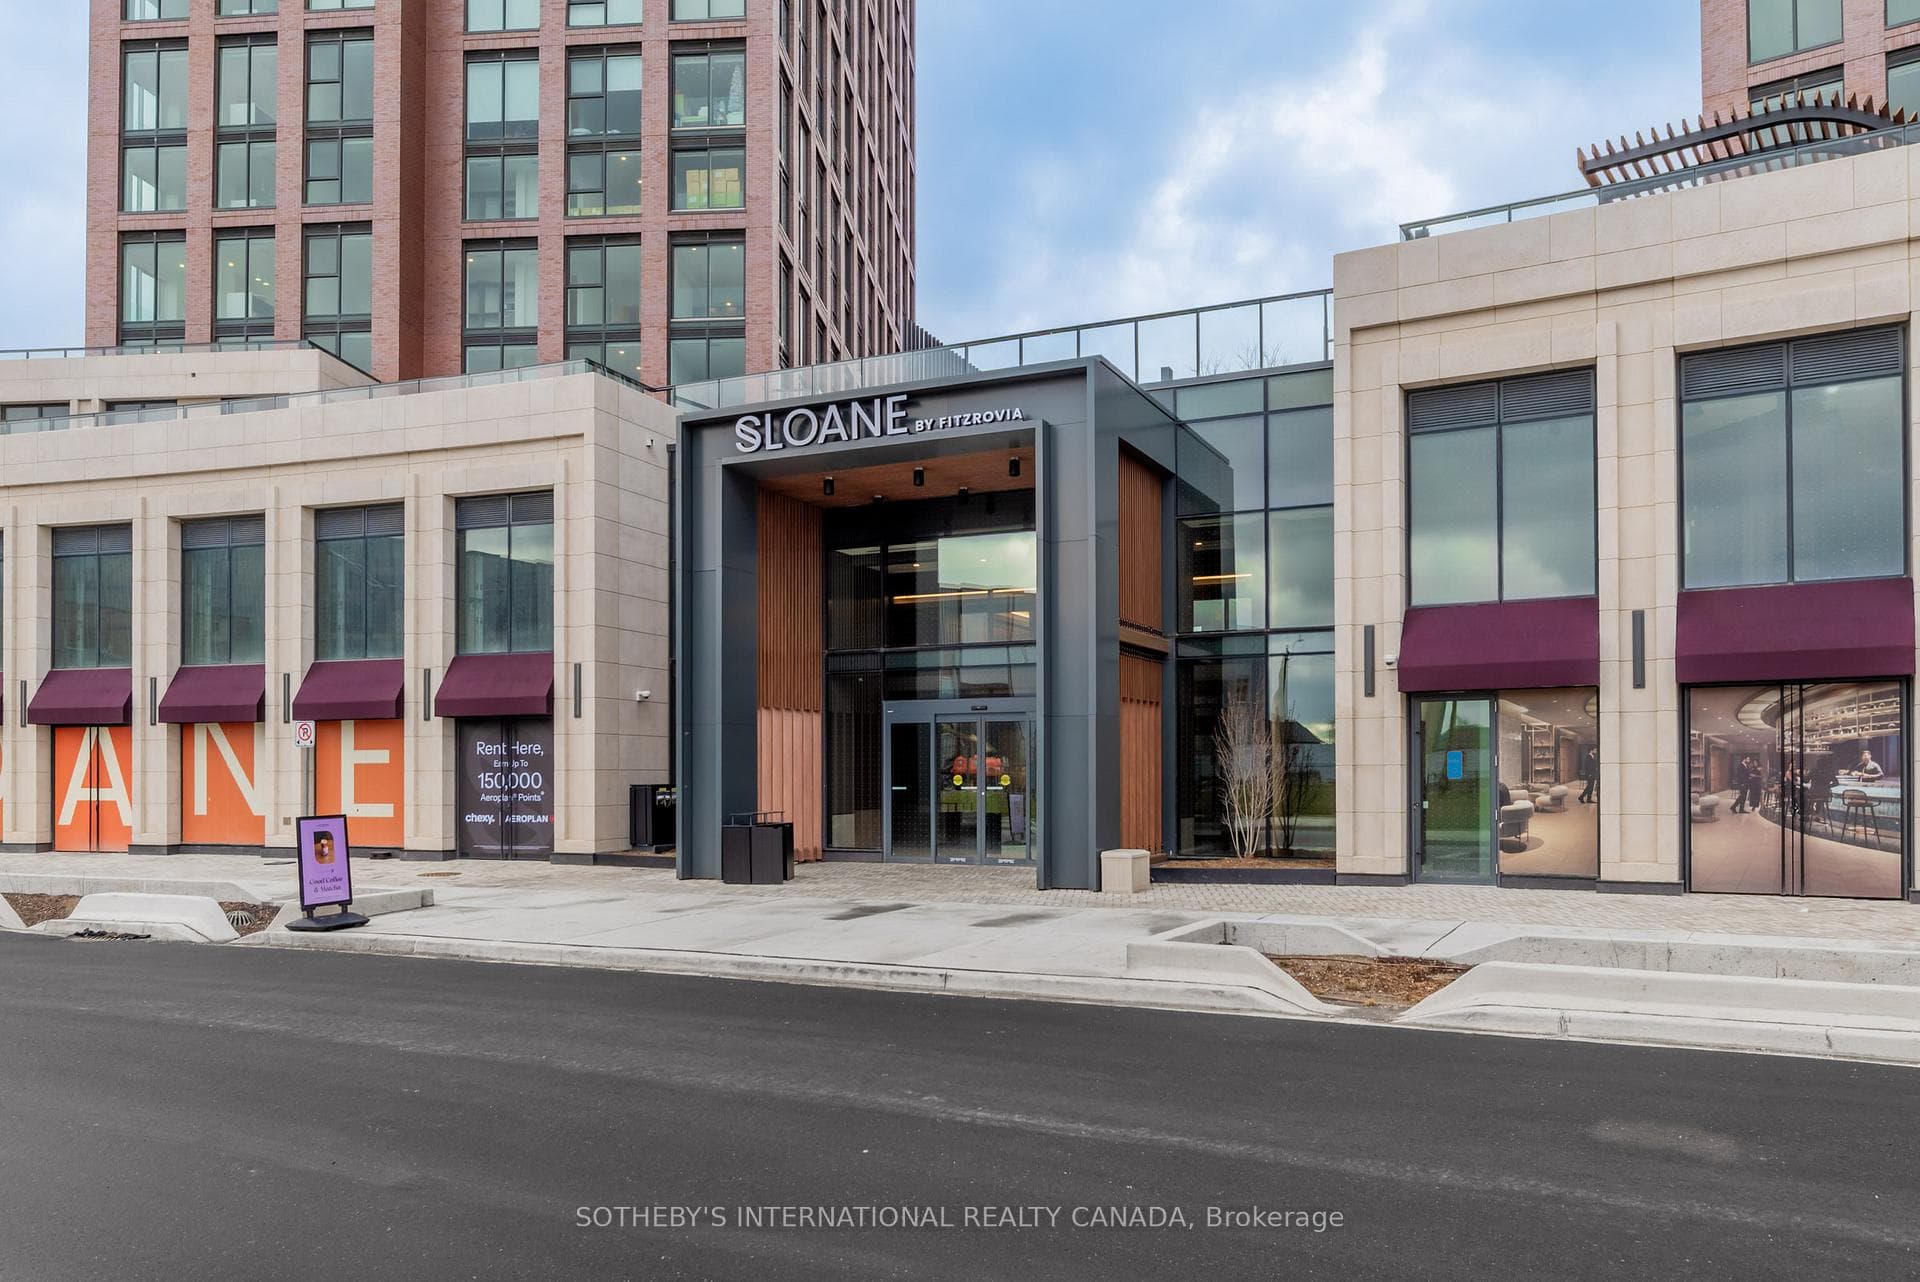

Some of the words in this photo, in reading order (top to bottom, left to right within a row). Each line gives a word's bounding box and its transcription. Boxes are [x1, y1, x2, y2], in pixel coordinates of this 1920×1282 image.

[735, 394, 908, 452] SLOANE
[915, 419, 934, 432] BY
[939, 407, 1023, 430] FITZROVIA
[476, 741, 507, 755] Rent
[477, 772, 542, 791] 150,000
[465, 812, 496, 825] chexy.
[505, 814, 549, 823] AEROPLAN
